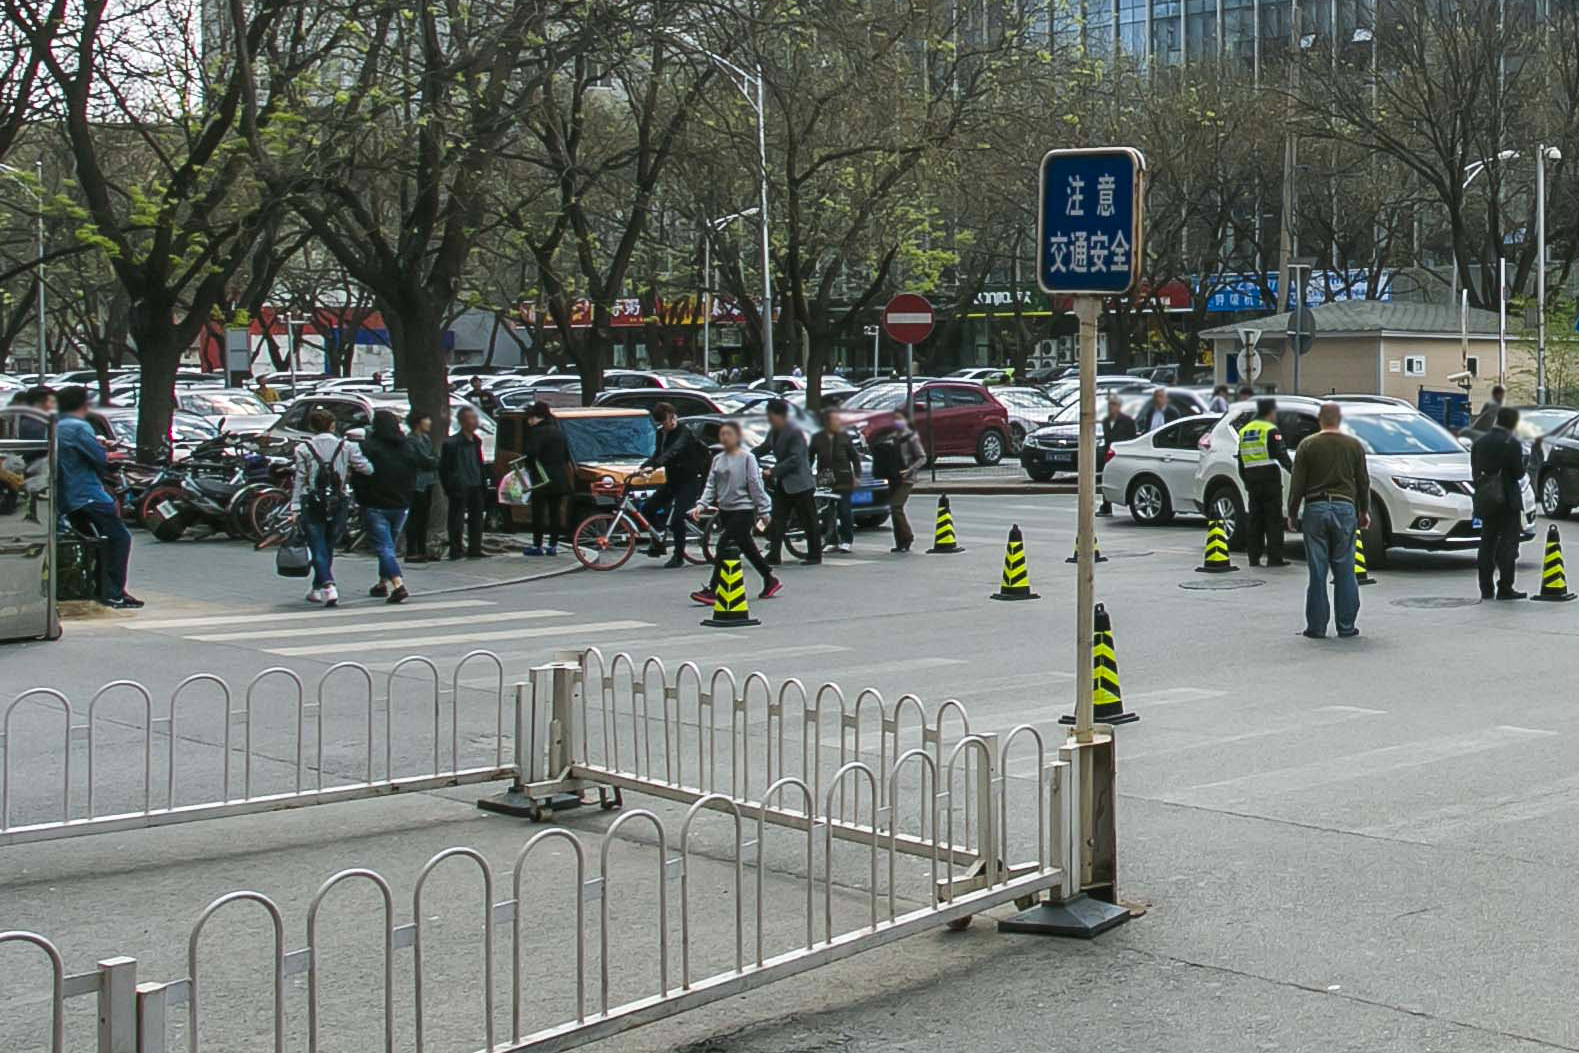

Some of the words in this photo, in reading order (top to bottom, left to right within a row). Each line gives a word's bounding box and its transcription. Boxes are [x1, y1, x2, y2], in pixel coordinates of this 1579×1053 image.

[1066, 173, 1115, 216] 注意
[1050, 230, 1131, 274] 交通安全
